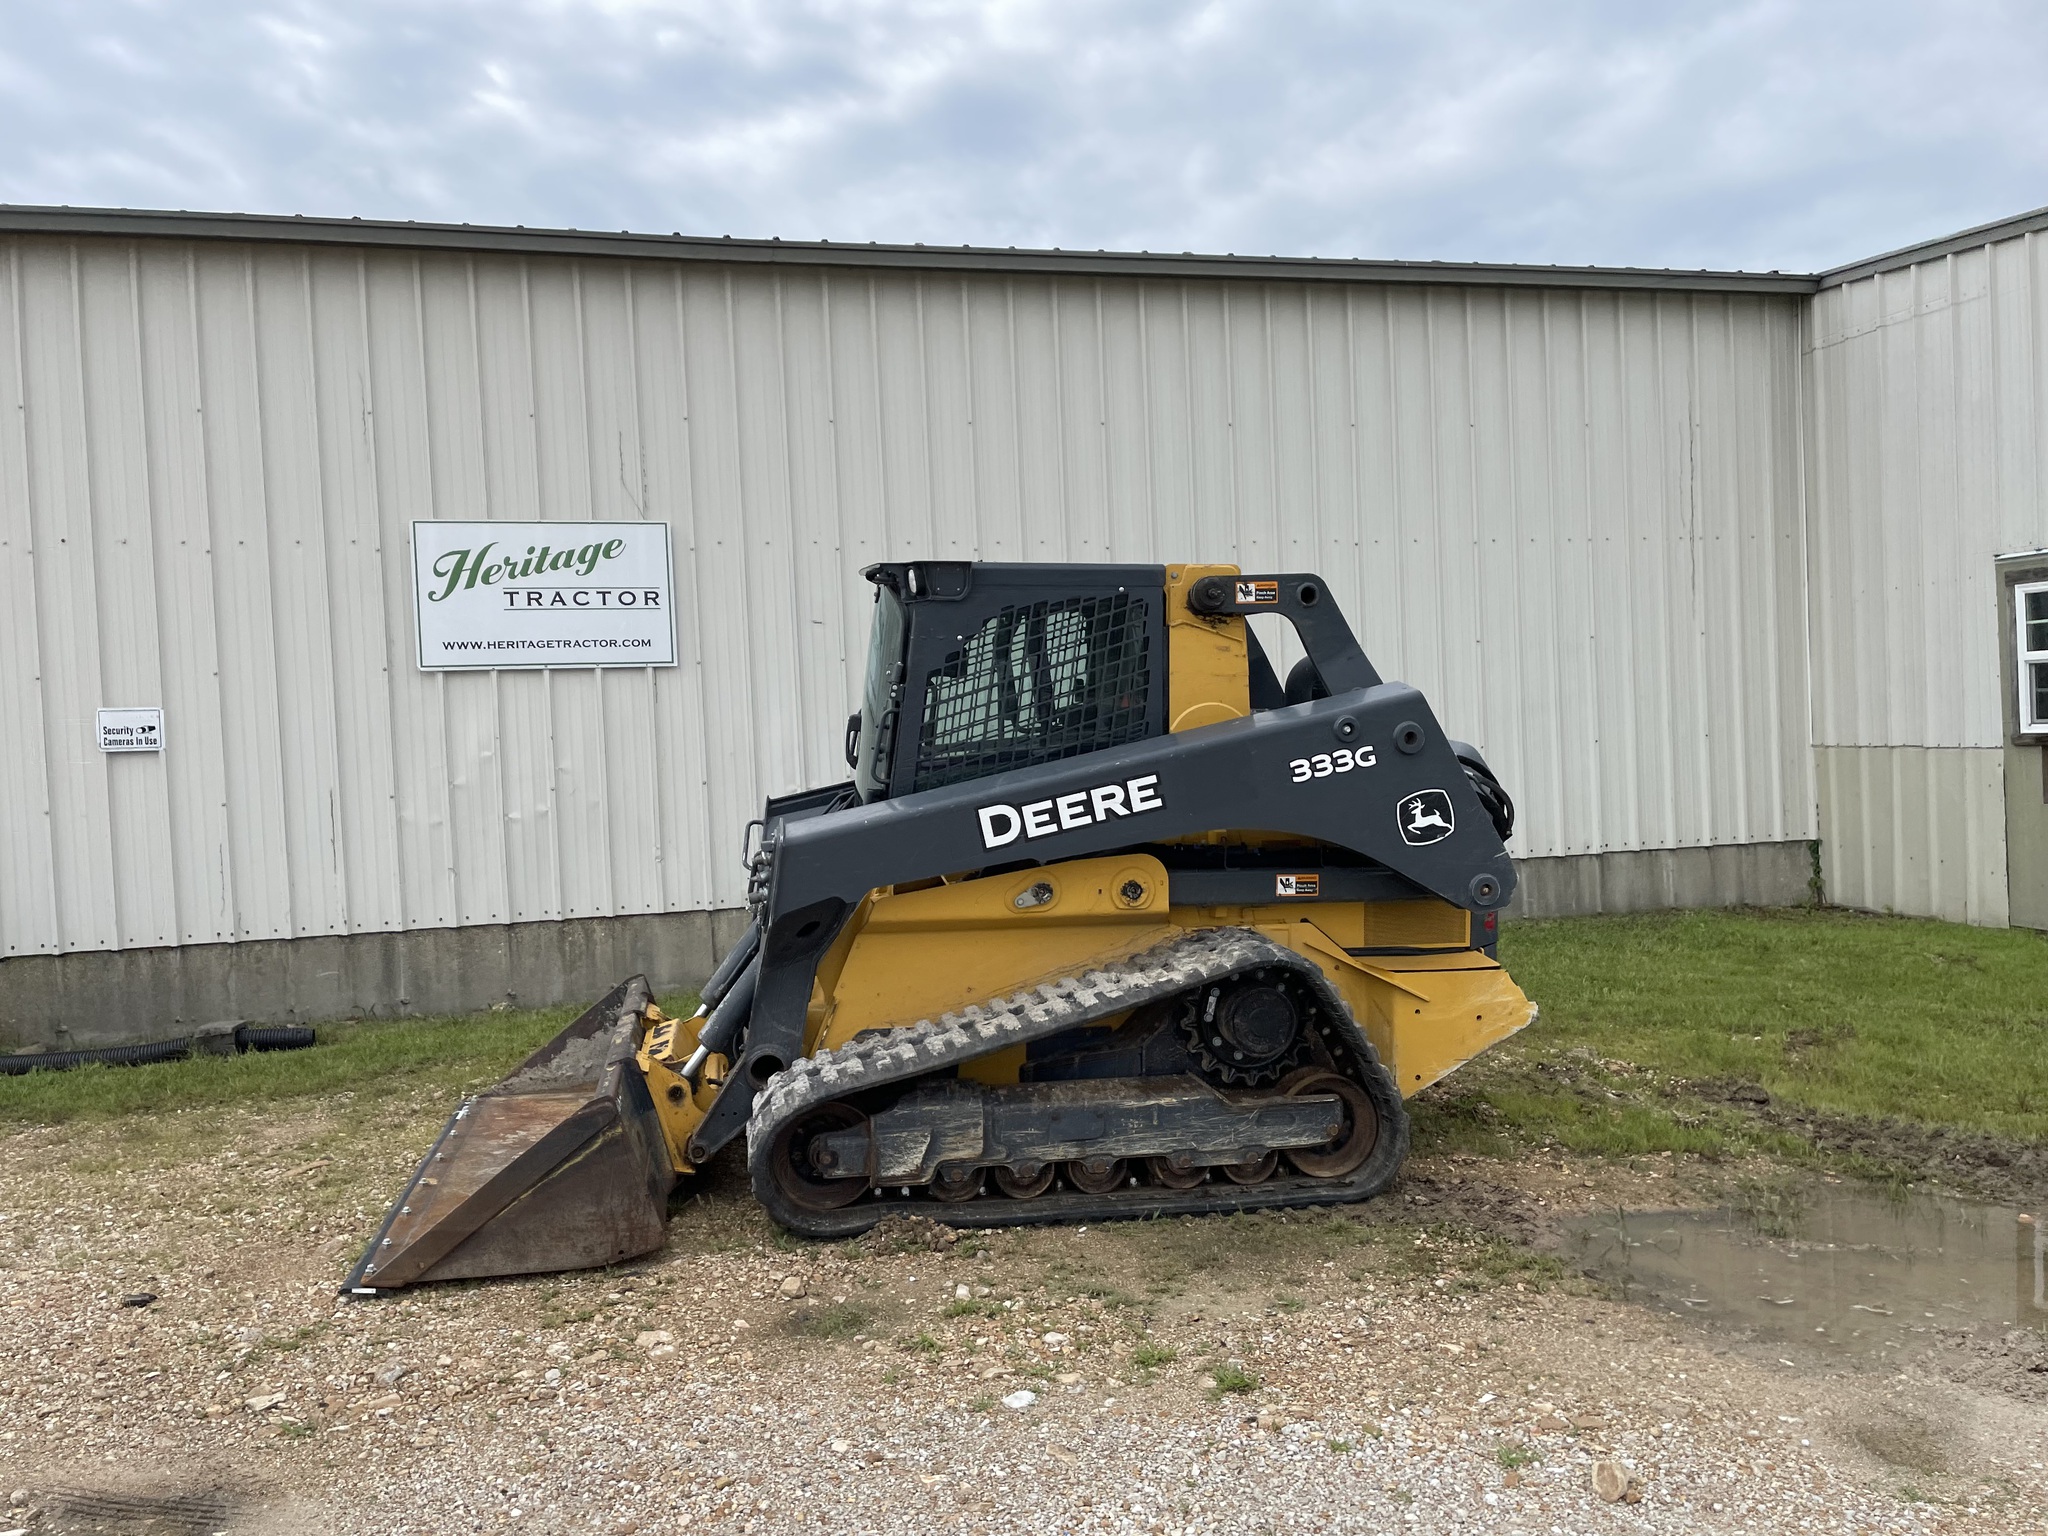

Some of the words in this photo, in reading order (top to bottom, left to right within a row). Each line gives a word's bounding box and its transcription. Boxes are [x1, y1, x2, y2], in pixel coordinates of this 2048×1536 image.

[428, 538, 626, 602] Heritage
[503, 590, 660, 607] TRACTOR
[442, 639, 652, 650] WWW.HERITAGETRACTOR.COM
[103, 726, 134, 736] Security
[103, 737, 134, 746] Cameras
[136, 737, 143, 746] In
[145, 736, 157, 746] Use
[1289, 745, 1377, 783] 333G
[977, 774, 1163, 850] DEERE
